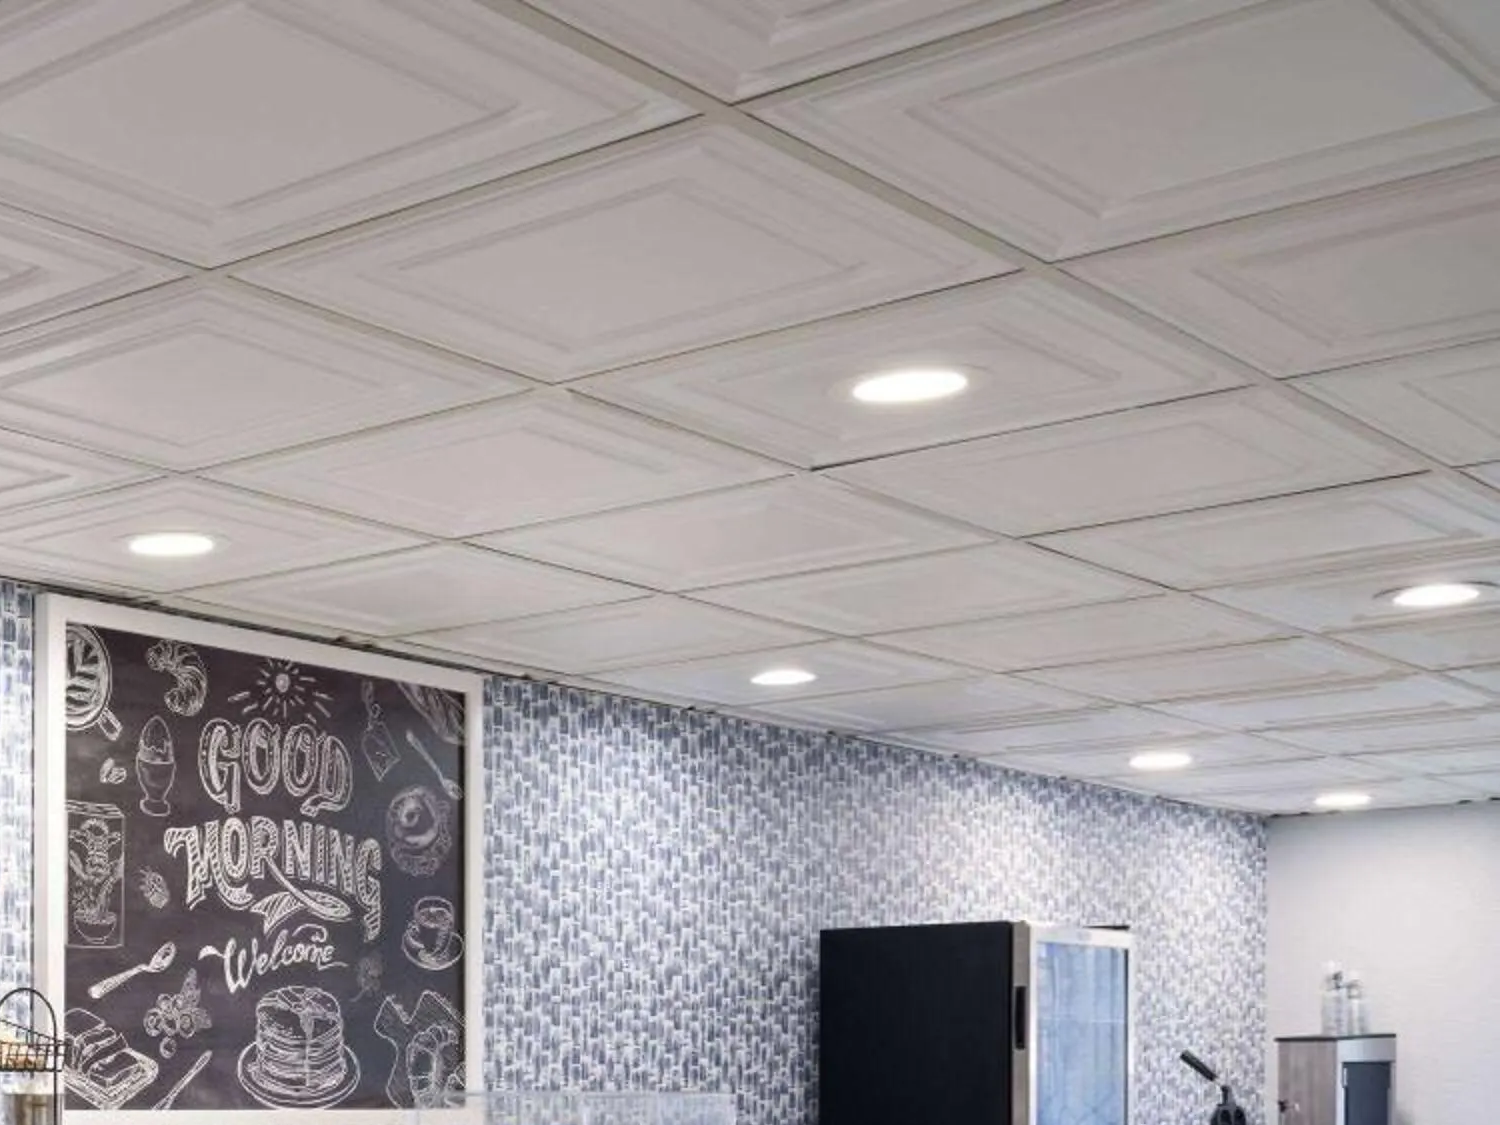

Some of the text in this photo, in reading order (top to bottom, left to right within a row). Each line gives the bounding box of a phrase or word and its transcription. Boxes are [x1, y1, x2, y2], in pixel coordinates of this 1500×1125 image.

[198, 717, 352, 816] GOOD
[163, 815, 382, 942] MORNING
[198, 923, 349, 994] Welcome
